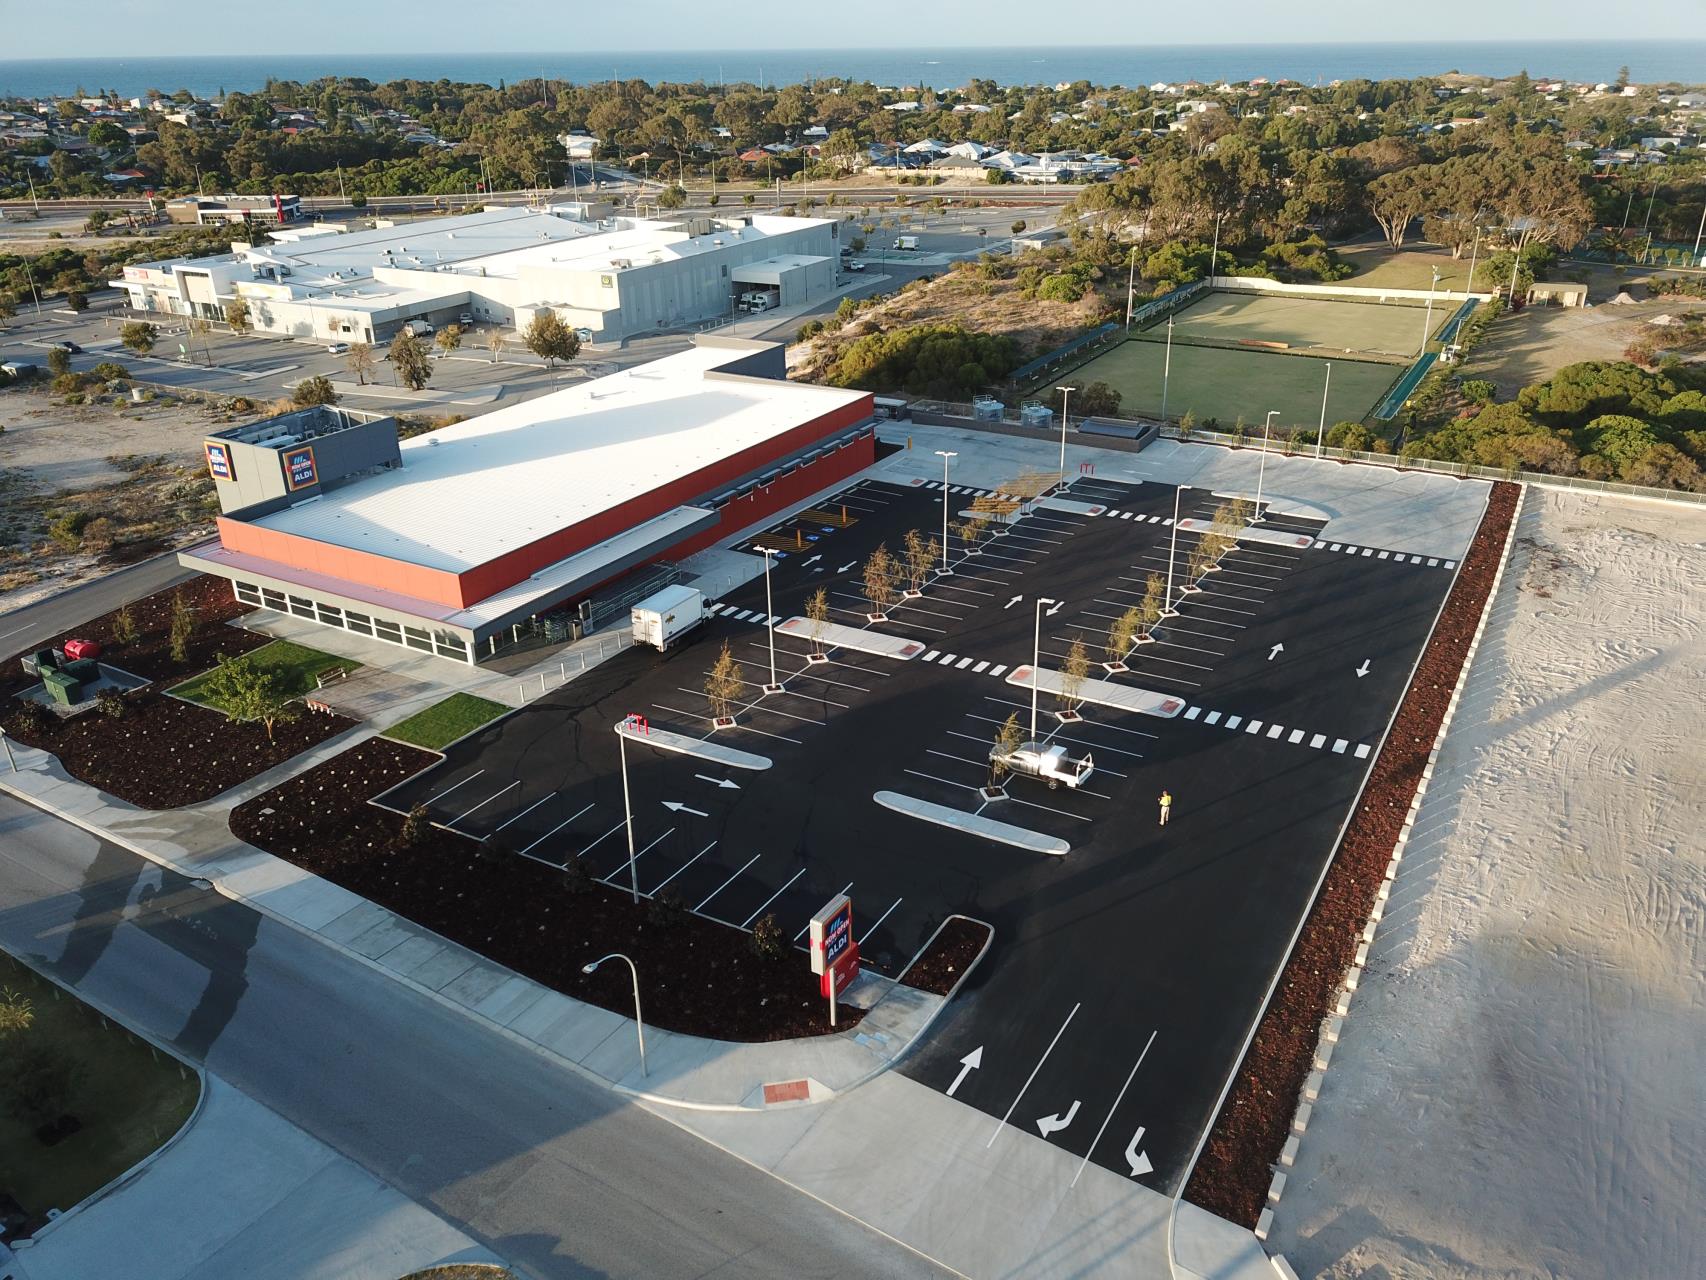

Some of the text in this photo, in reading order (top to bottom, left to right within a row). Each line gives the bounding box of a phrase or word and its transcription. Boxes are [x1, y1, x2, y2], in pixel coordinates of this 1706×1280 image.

[295, 470, 312, 481] ALDI
[825, 932, 837, 946] NOW
[837, 919, 850, 935] OPEN
[828, 935, 847, 959] ALDI
